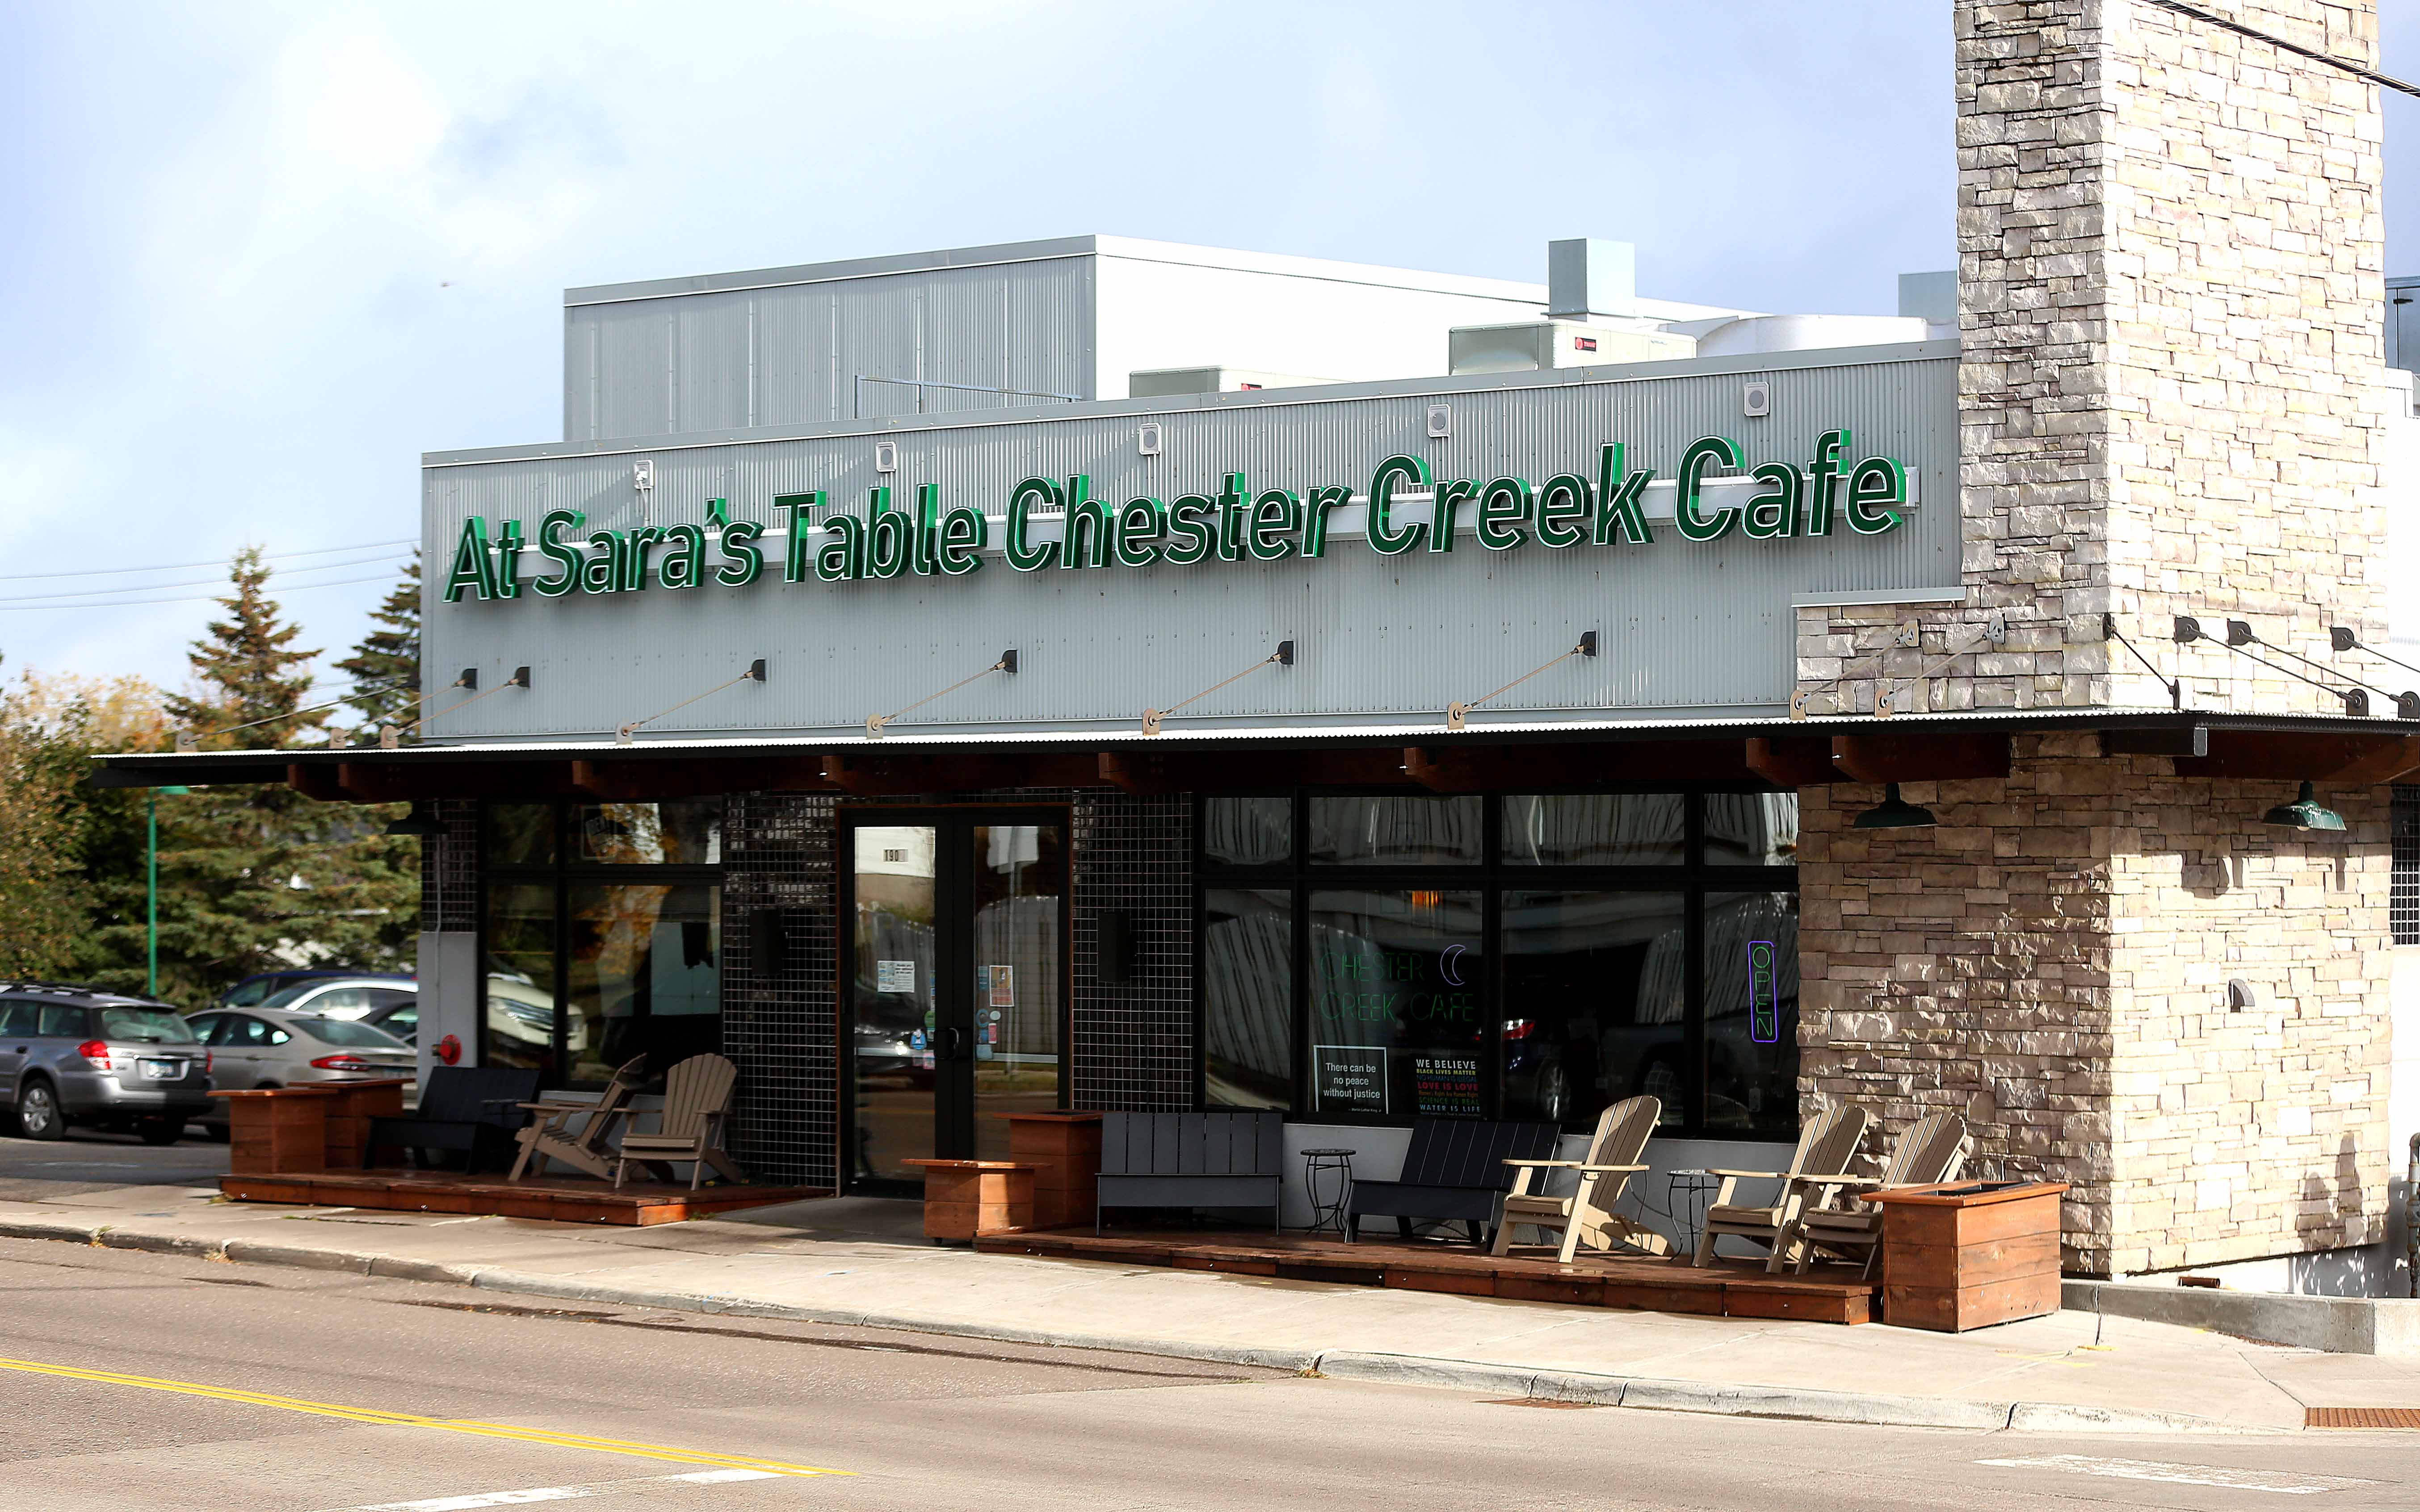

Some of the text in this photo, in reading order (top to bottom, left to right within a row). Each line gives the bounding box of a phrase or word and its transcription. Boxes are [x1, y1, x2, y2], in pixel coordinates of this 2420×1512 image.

[442, 429, 1907, 603] At Sara's Table Chester Creek Cafe
[1320, 952, 1424, 982] CHESTER
[1752, 946, 1773, 1037] OPEN
[1321, 991, 1474, 1022] CREEK CAFE
[1325, 1062, 1348, 1072] There
[1366, 1063, 1376, 1073] be
[1416, 1059, 1476, 1069] WE BELIEVE
[1345, 1078, 1370, 1087] peace
[1417, 1081, 1479, 1091] LOVE IS LOVE
[1323, 1088, 1381, 1100] without justice
